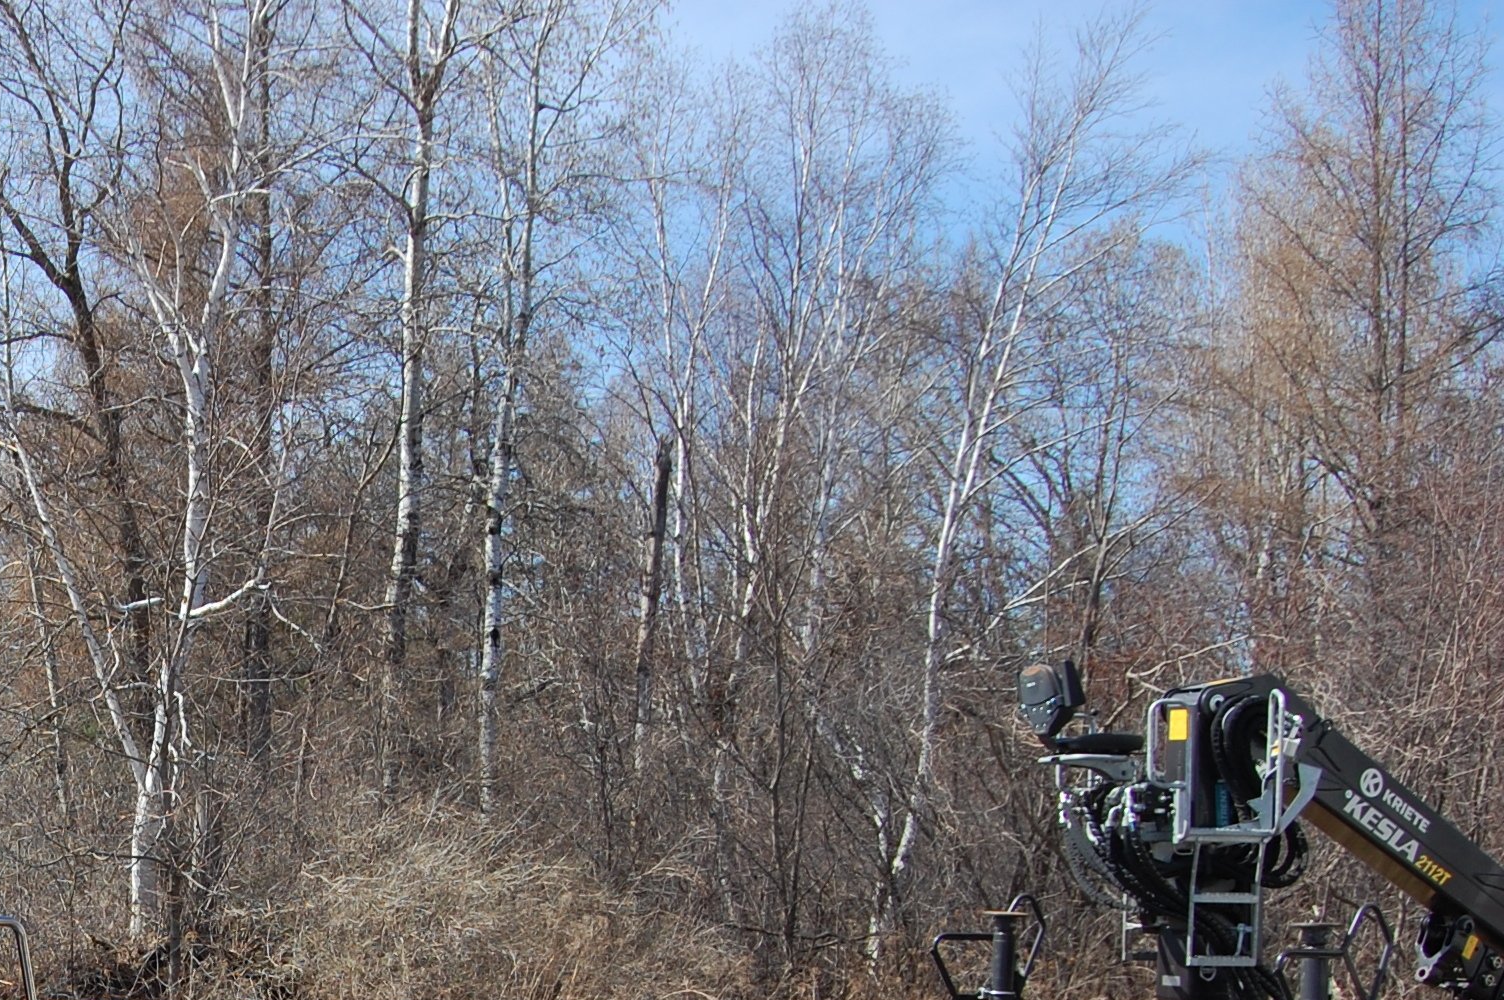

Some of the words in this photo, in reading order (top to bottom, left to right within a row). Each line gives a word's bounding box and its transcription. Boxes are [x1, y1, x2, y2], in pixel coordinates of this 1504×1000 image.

[1343, 793, 1420, 864] KESLA
[1414, 855, 1452, 886] 2112T
[1382, 788, 1431, 834] KRIETE
